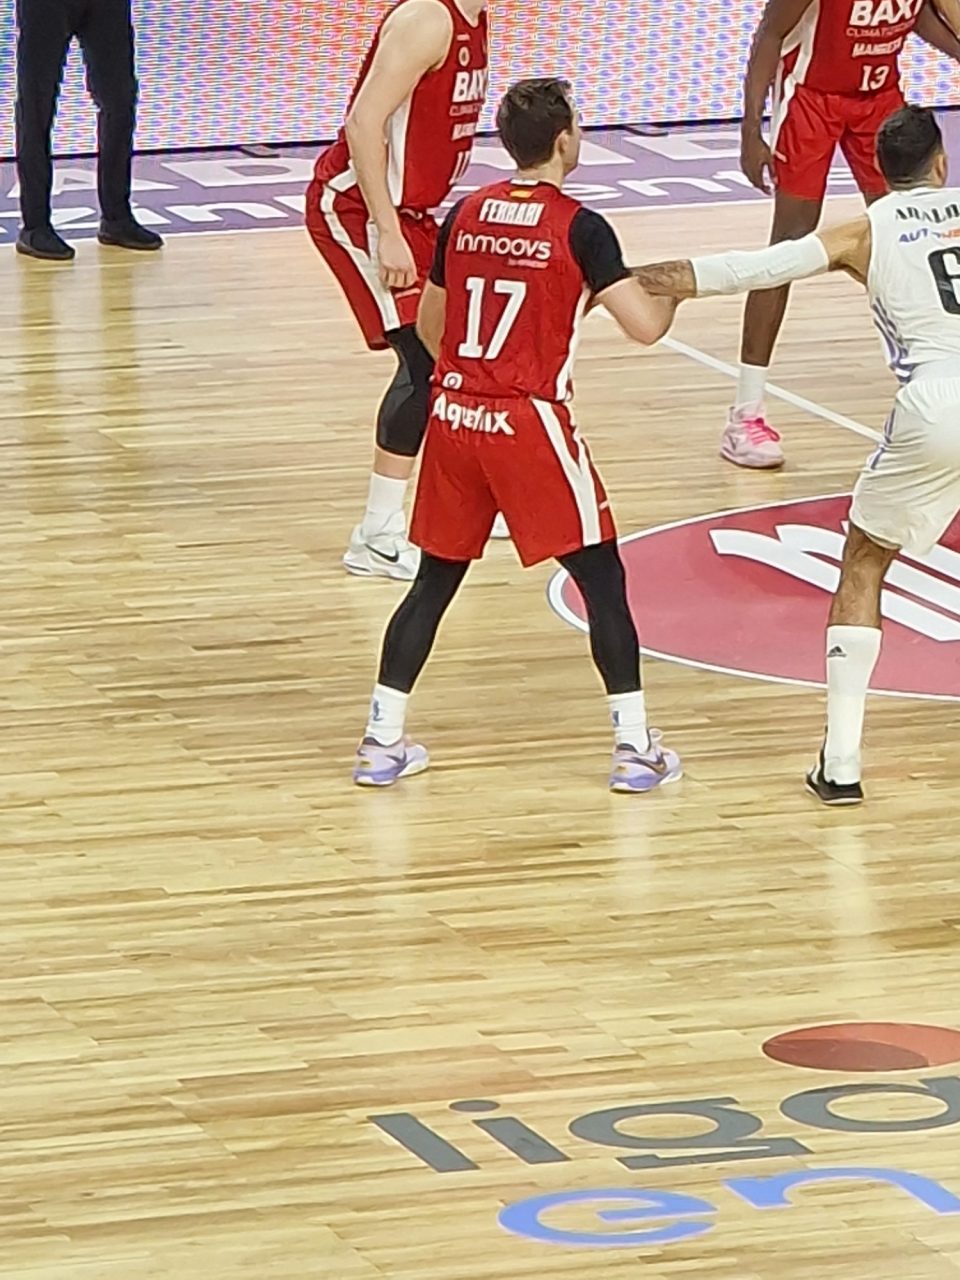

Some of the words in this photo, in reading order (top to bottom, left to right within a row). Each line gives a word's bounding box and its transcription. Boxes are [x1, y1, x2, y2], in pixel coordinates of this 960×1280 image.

[859, 65, 890, 92] 13
[479, 198, 545, 226] FERRARI
[456, 230, 551, 260] inmoovs
[458, 276, 527, 360] 17
